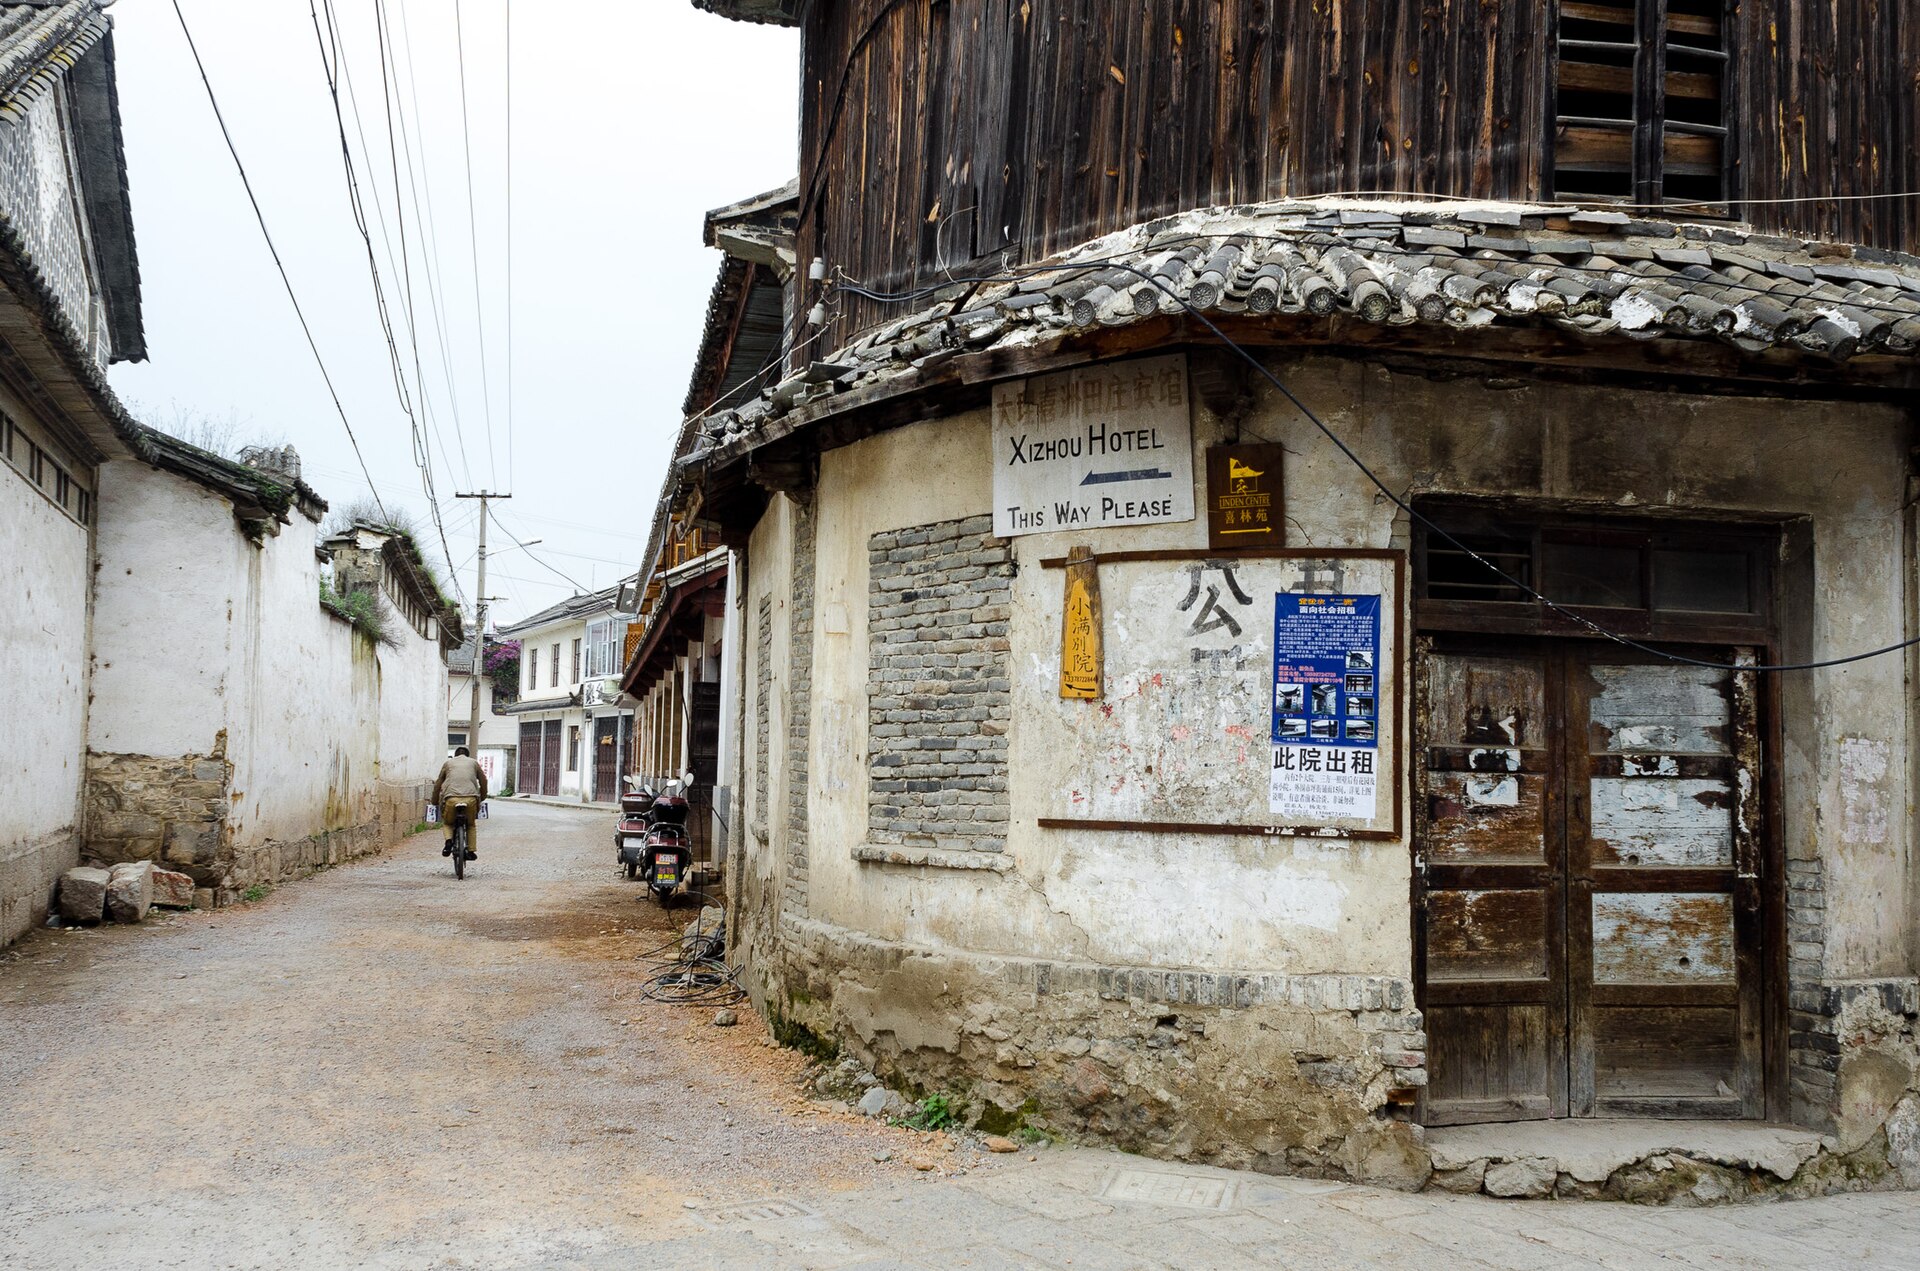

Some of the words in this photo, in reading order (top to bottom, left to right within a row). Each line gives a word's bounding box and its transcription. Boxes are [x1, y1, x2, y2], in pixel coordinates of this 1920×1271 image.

[1089, 423, 1164, 455] HOTEL
[1055, 501, 1091, 524] WAY
[1102, 497, 1172, 520] PLEASE
[1220, 497, 1244, 508] LINDEN
[1245, 496, 1270, 507] CENTRE
[1225, 509, 1268, 524] 喜林苑
[1299, 606, 1356, 615] 面向社会招租
[1273, 747, 1374, 774] 此院出租
